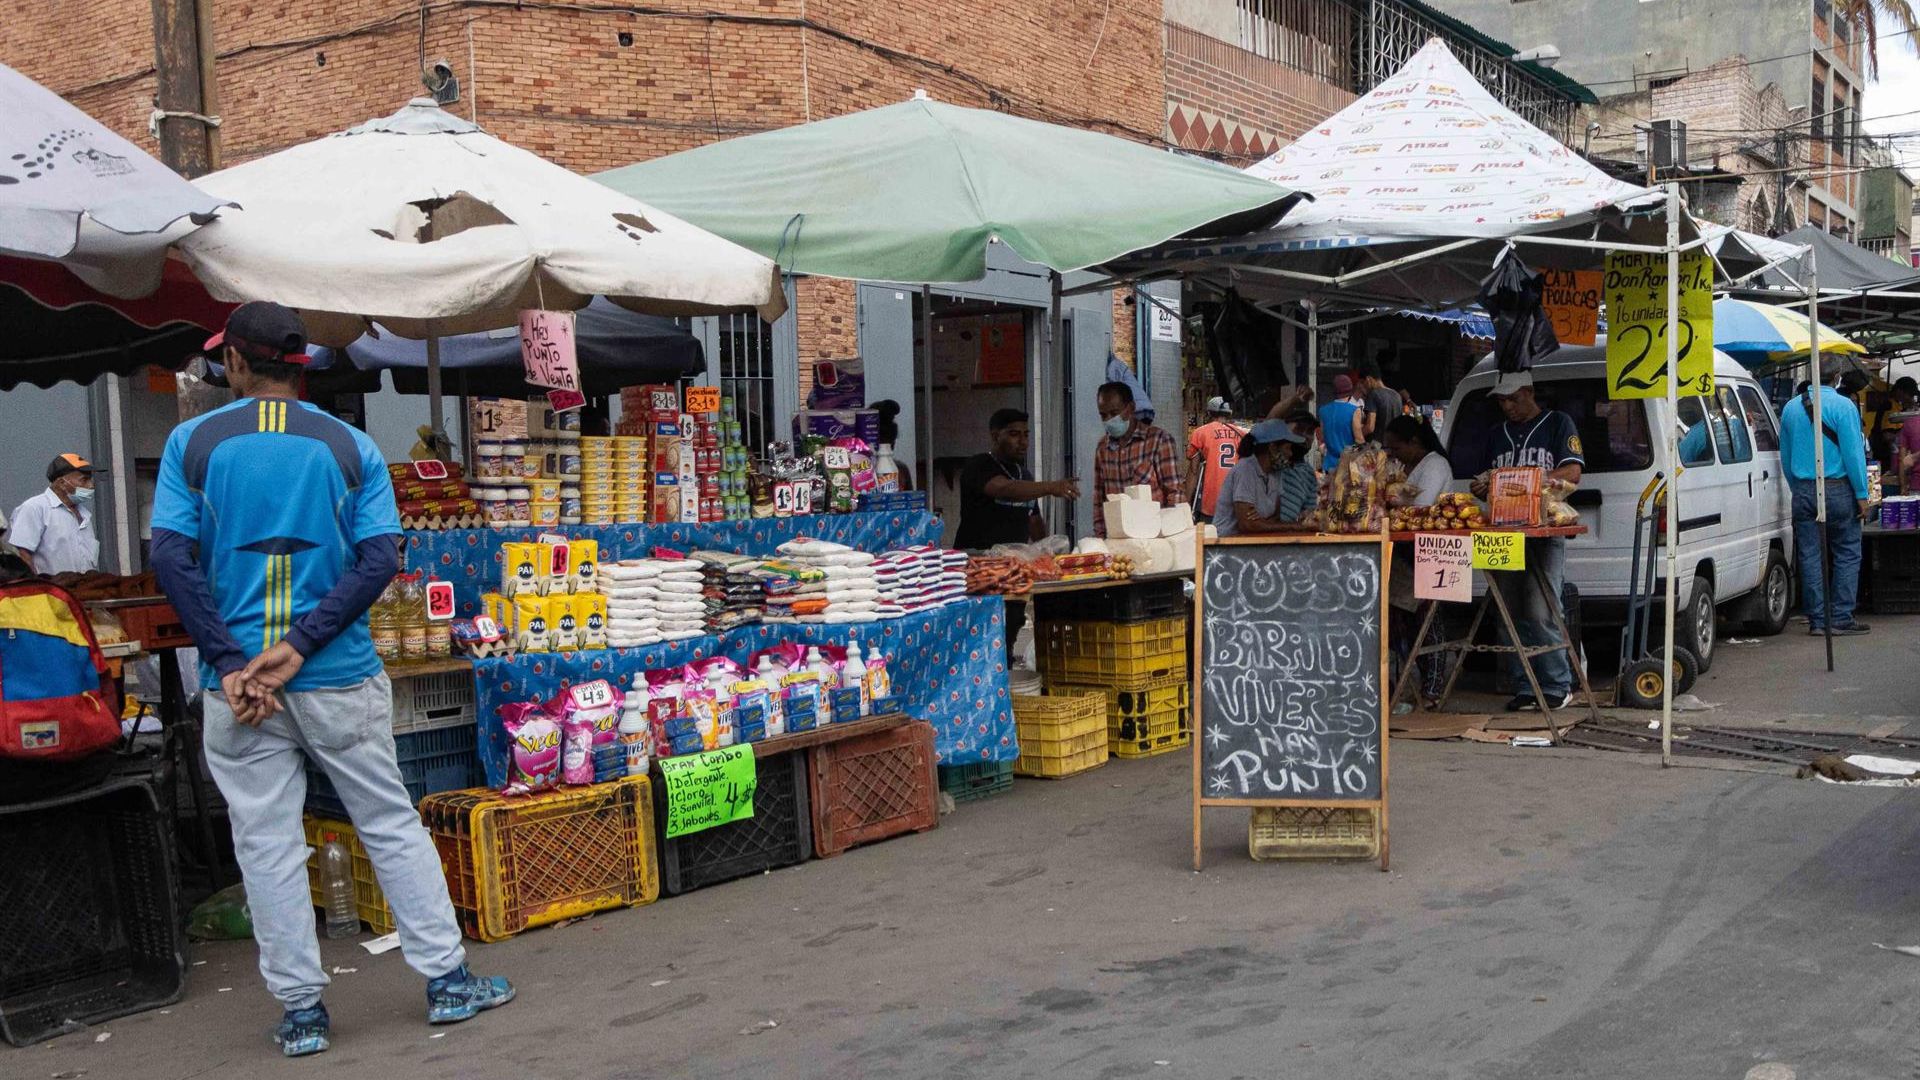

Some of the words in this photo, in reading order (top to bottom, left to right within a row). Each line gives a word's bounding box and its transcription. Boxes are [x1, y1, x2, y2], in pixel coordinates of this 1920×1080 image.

[1608, 270, 1638, 289] Don
[1615, 305, 1630, 324] 16
[483, 408, 503, 432] 1$
[1220, 443, 1235, 469] 2
[777, 488, 792, 509] 1$
[795, 487, 809, 511] 1$
[1418, 537, 1463, 549] UNIDAD
[1473, 534, 1514, 547] PAQUETE
[553, 549, 566, 570] 1$
[517, 731, 559, 755] Vea
